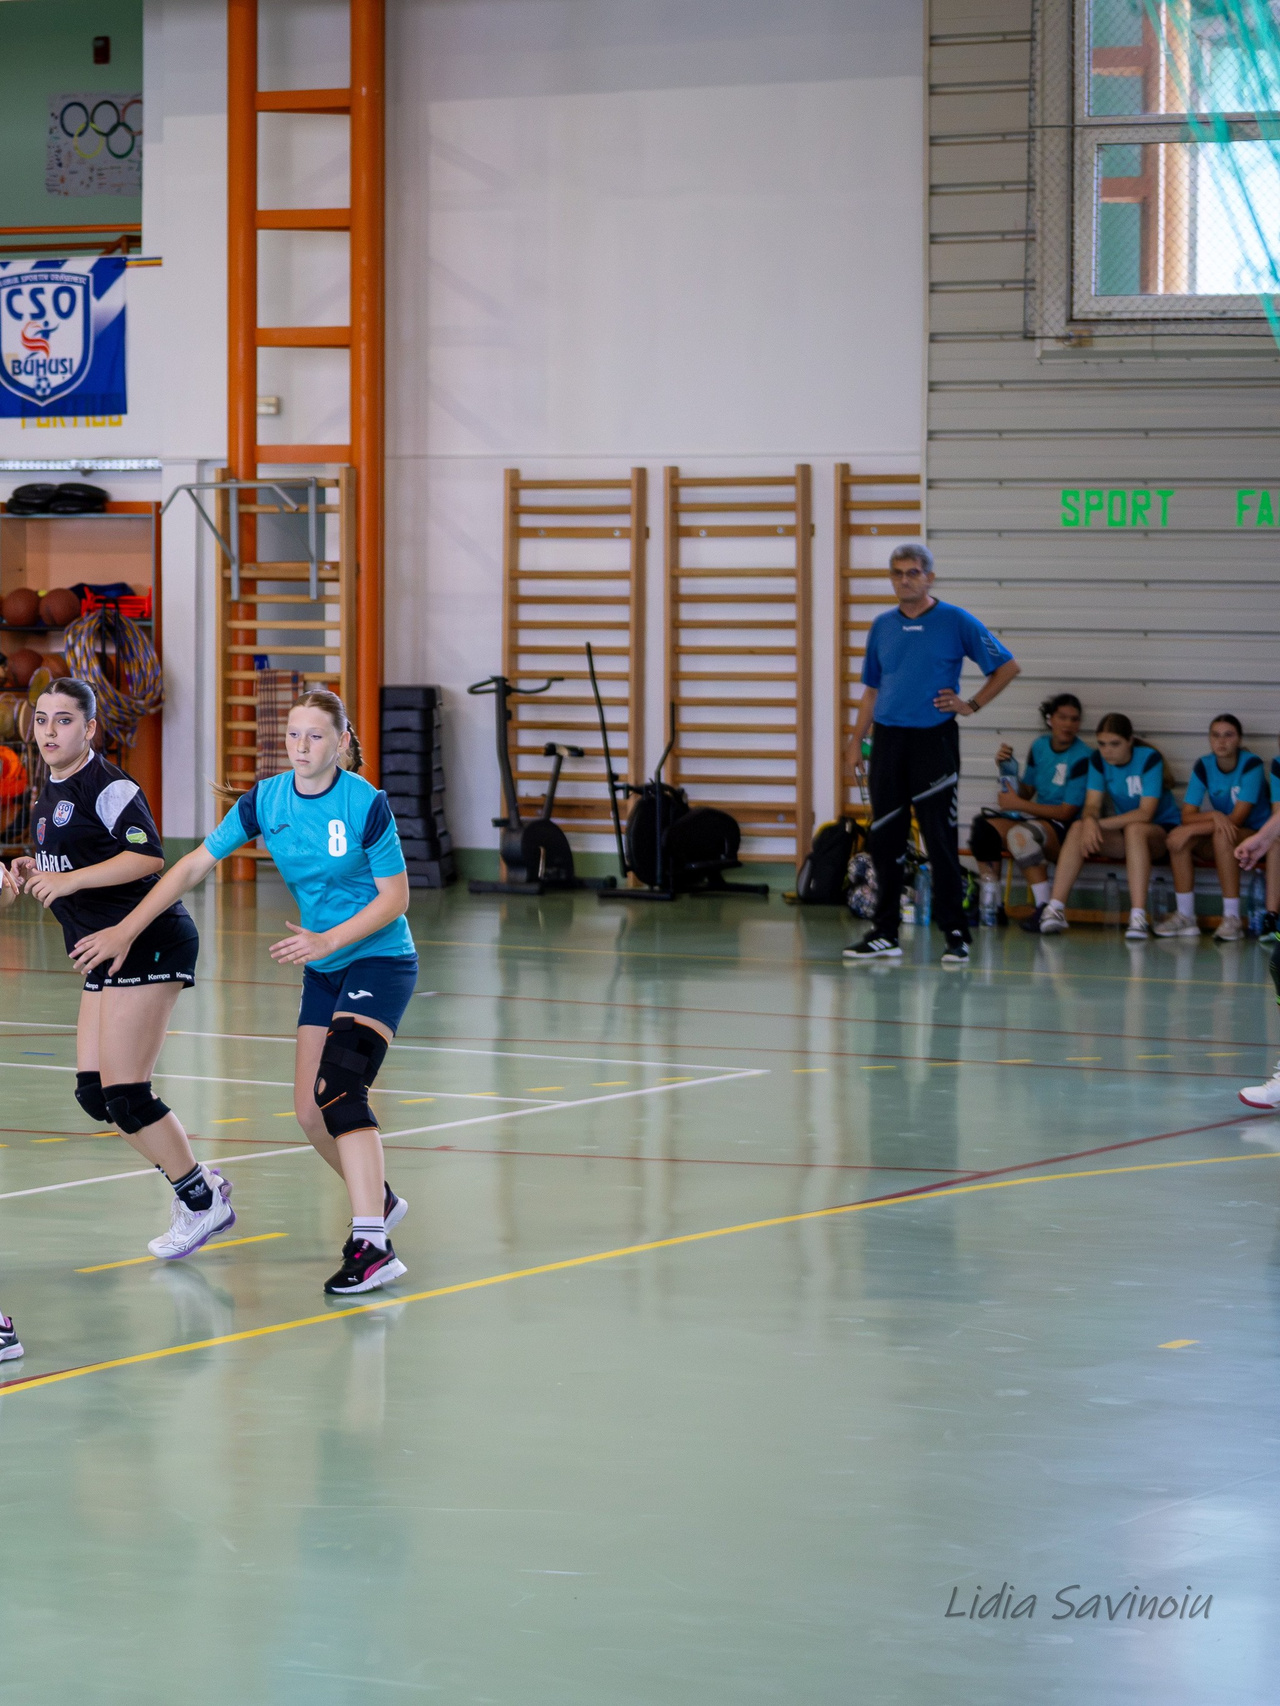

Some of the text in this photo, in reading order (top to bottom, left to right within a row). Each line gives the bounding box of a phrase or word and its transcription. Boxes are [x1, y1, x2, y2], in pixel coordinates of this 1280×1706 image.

[6, 286, 77, 321] CSO
[1061, 489, 1280, 527] SPORT FA
[328, 819, 347, 857] 8
[35, 850, 74, 873] MĂRIA
[118, 977, 141, 985] Kempa
[148, 973, 170, 981] Kempa
